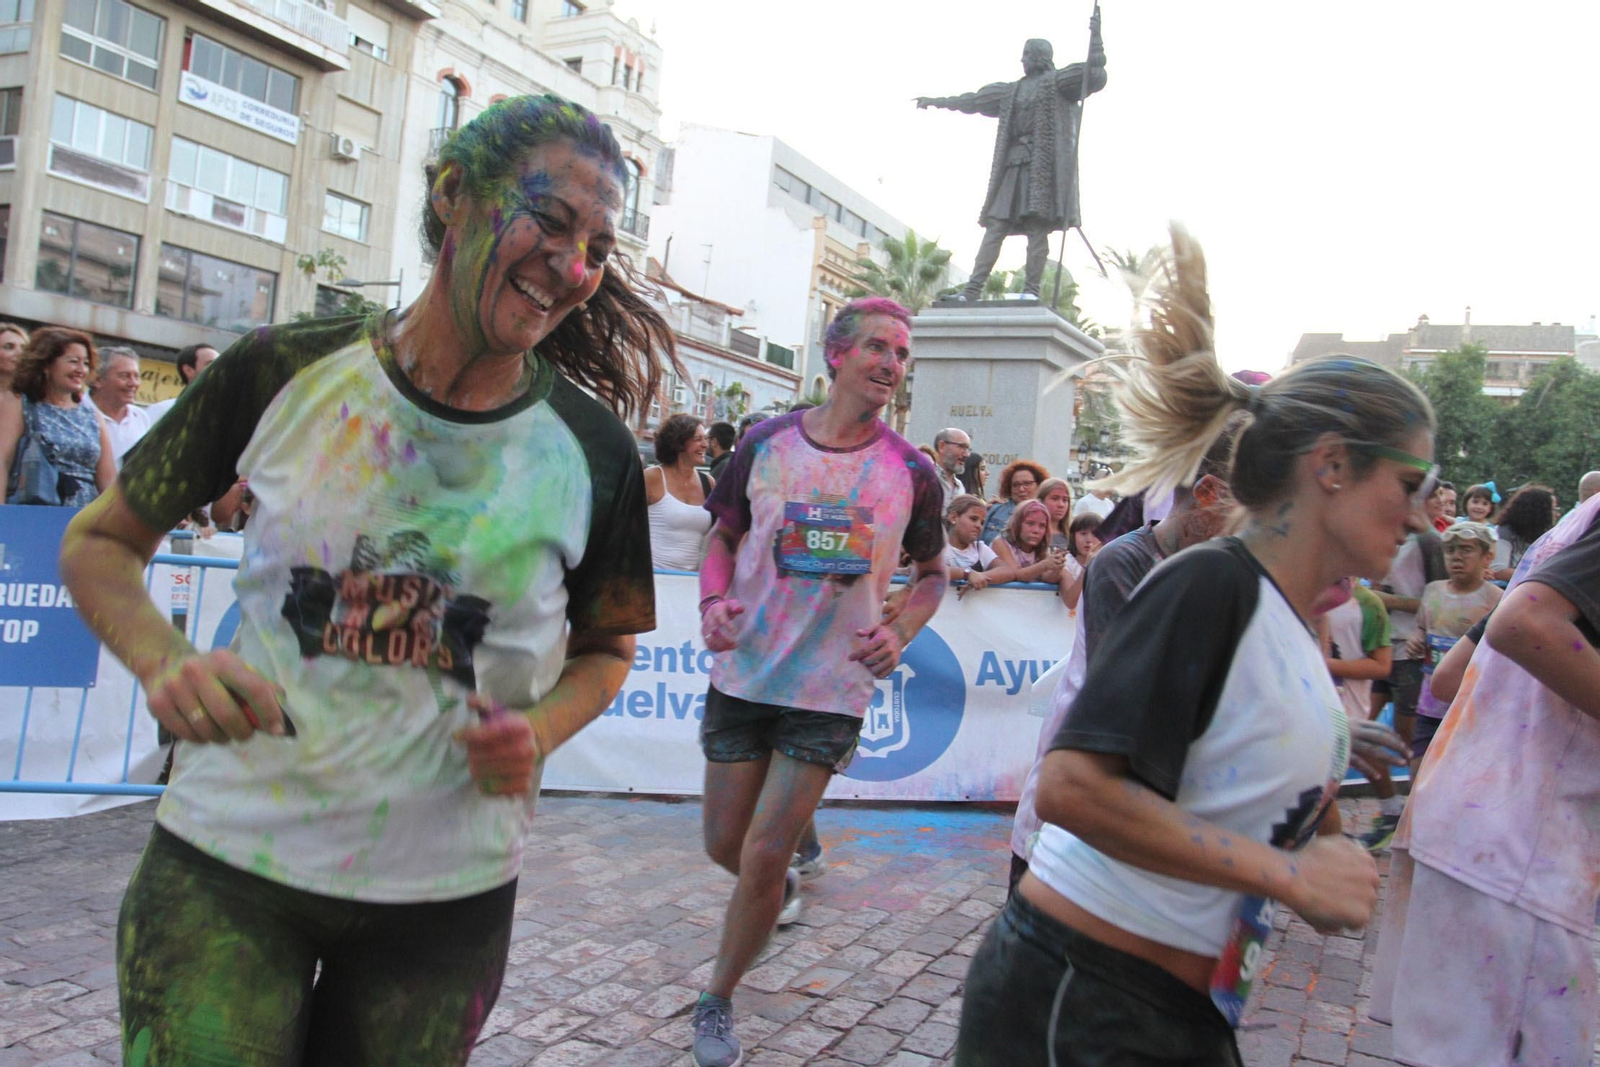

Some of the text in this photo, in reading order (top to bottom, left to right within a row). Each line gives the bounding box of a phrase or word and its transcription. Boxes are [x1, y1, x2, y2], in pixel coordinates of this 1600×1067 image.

[950, 405, 993, 417] HUELVA
[806, 530, 850, 551] 857
[0, 619, 39, 643] OP
